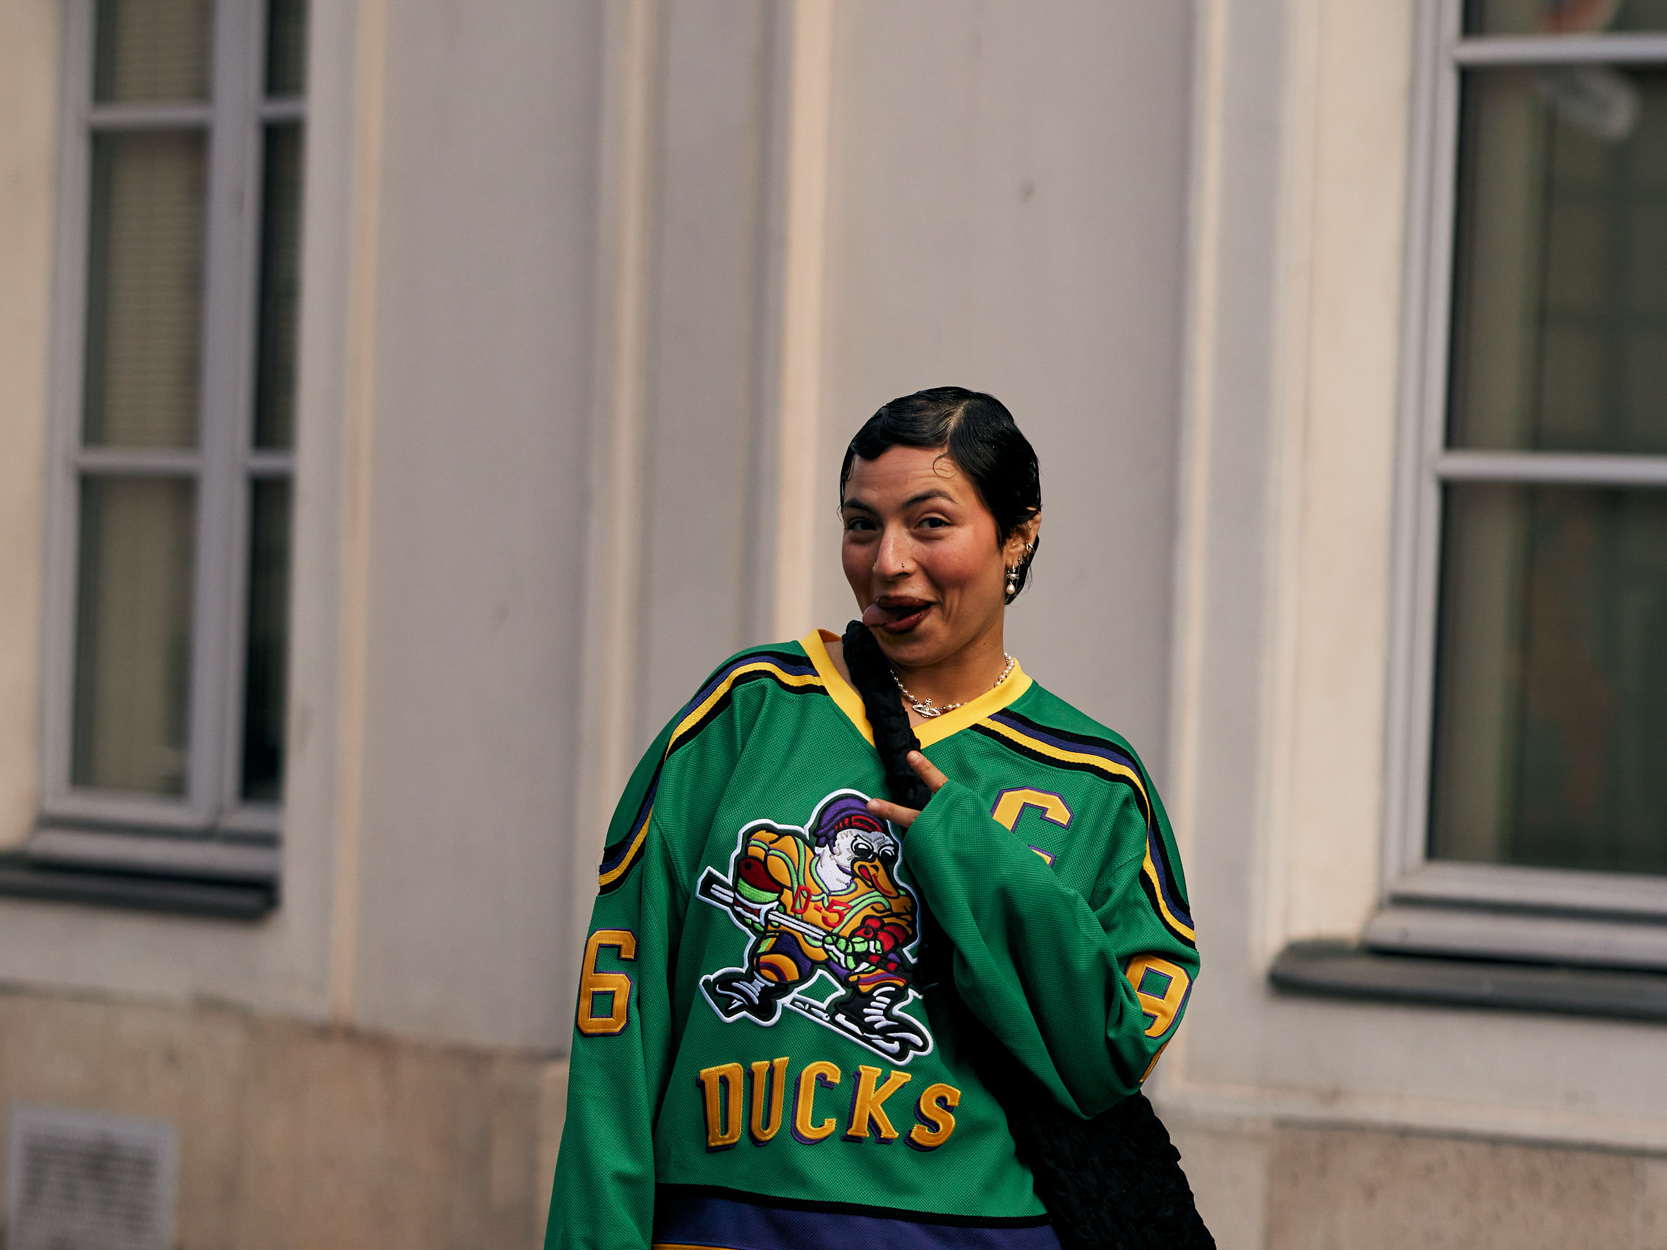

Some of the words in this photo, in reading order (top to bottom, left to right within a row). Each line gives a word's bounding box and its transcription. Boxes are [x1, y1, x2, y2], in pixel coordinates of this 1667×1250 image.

[576, 927, 638, 1037] 6
[1124, 954, 1192, 1039] 9
[696, 1056, 962, 1153] DUCKS
